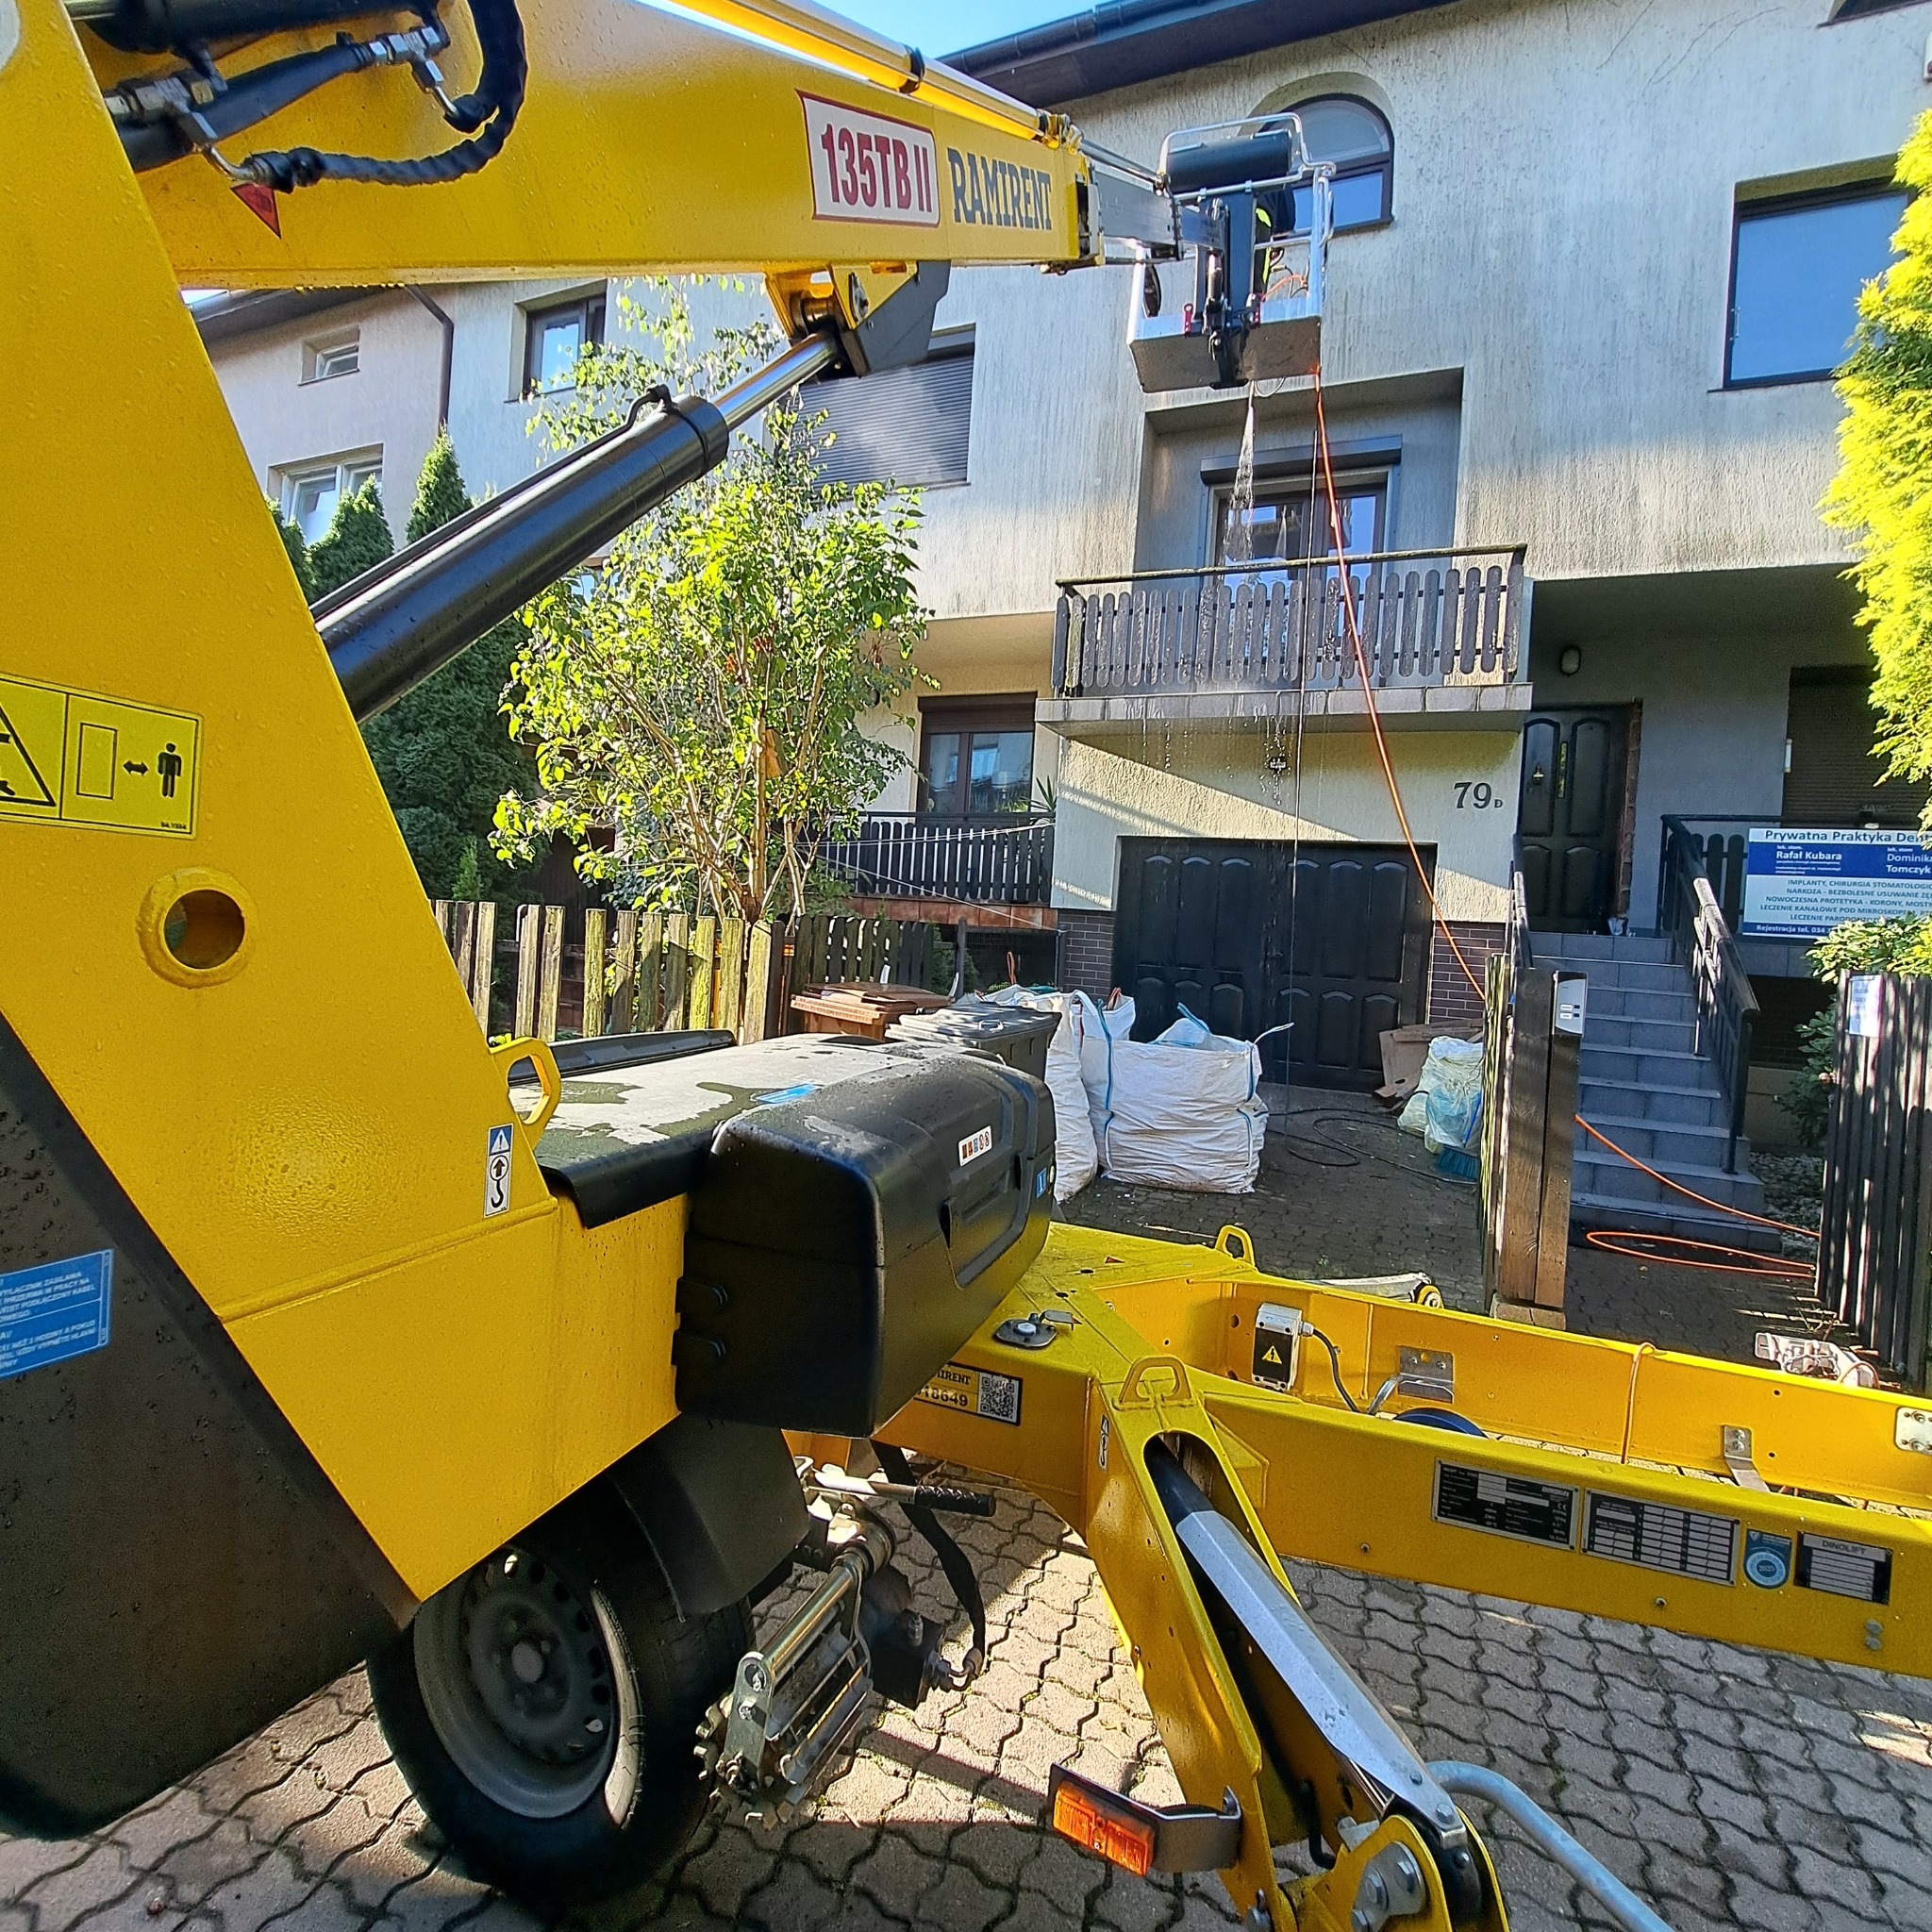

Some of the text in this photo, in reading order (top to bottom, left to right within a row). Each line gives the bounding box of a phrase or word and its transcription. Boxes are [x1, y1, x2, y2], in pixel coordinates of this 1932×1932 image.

[821, 123, 912, 209] 135TB
[946, 147, 1053, 230] RAMIRENT
[1765, 830, 1828, 842] Prywatna
[1832, 832, 1891, 844] Praktyka
[1776, 850, 1842, 860] Rafał Kubara
[1886, 865, 1931, 875] Tomczyk
[918, 1385, 968, 1407] 18649
[1822, 1540, 1866, 1555] DINOLIFT
